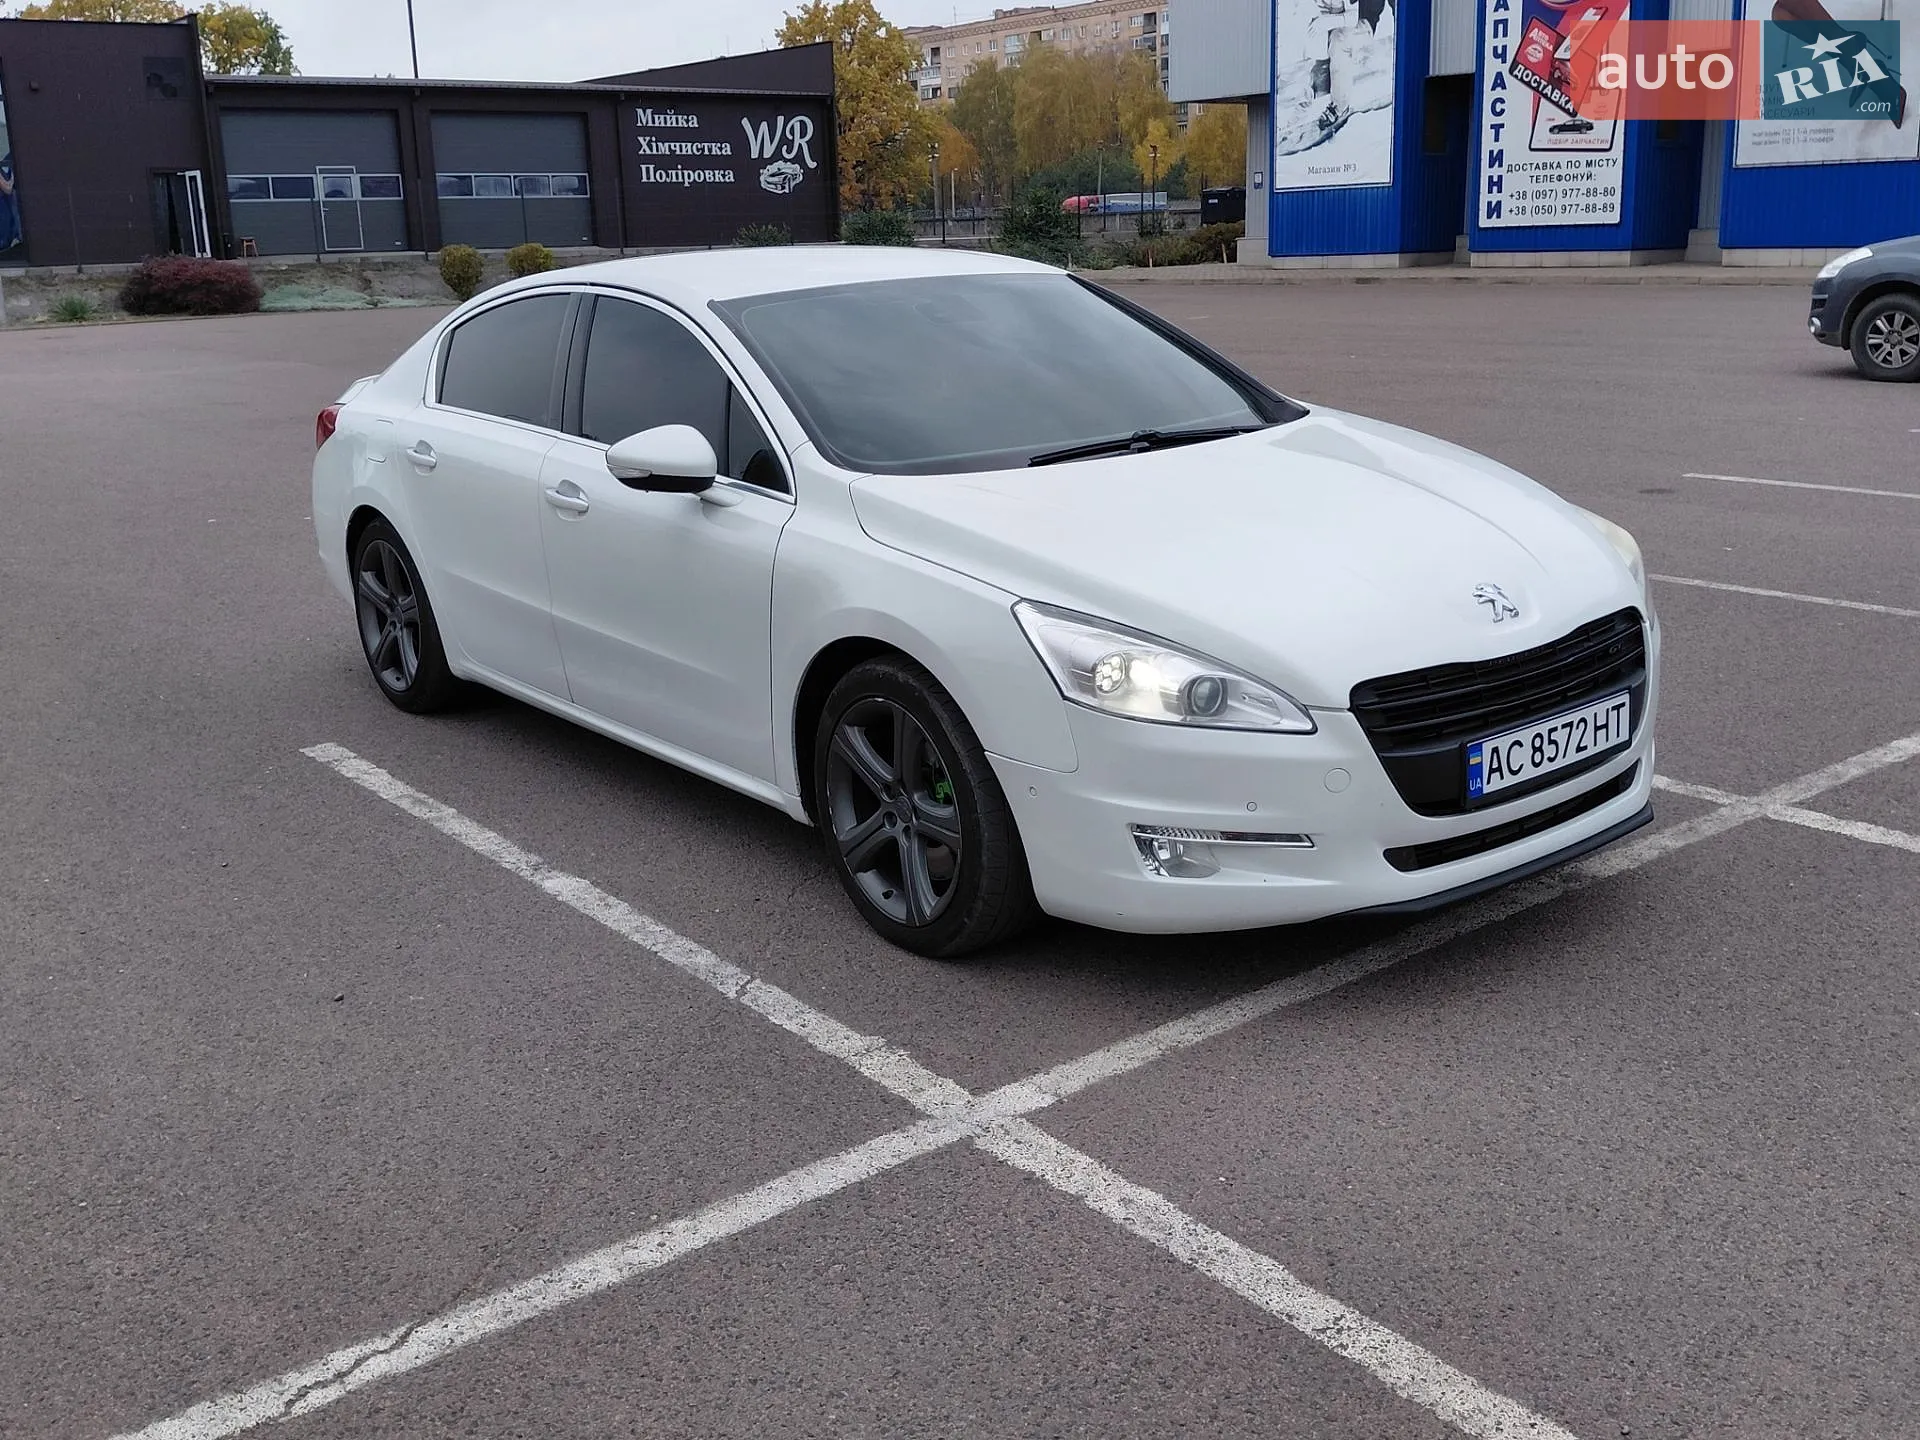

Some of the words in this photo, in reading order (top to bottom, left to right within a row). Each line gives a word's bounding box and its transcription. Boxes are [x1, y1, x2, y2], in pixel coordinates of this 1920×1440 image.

[1513, 64, 1574, 113] ДОСТАВКА
[635, 108, 699, 128] Мийка
[637, 136, 732, 156] Хімчистка
[741, 115, 818, 169] WR
[640, 164, 735, 186] Поліровка
[1506, 161, 1562, 174] ДОСТАВКА
[1566, 160, 1581, 170] ПО
[1585, 158, 1618, 168] МІСТУ
[1529, 171, 1597, 184] ТЕЛЕФОНУЙ:
[1509, 190, 1528, 200] +38
[1531, 188, 1558, 202] (097)
[1561, 186, 1616, 199] 977-88-80
[1508, 205, 1527, 216] +38
[1530, 204, 1557, 217] (050)
[1560, 202, 1615, 215] 977-88-89
[1486, 740, 1524, 785] AC
[1531, 717, 1588, 769] 8572
[1593, 701, 1626, 747] HT
[1469, 777, 1482, 791] UA
